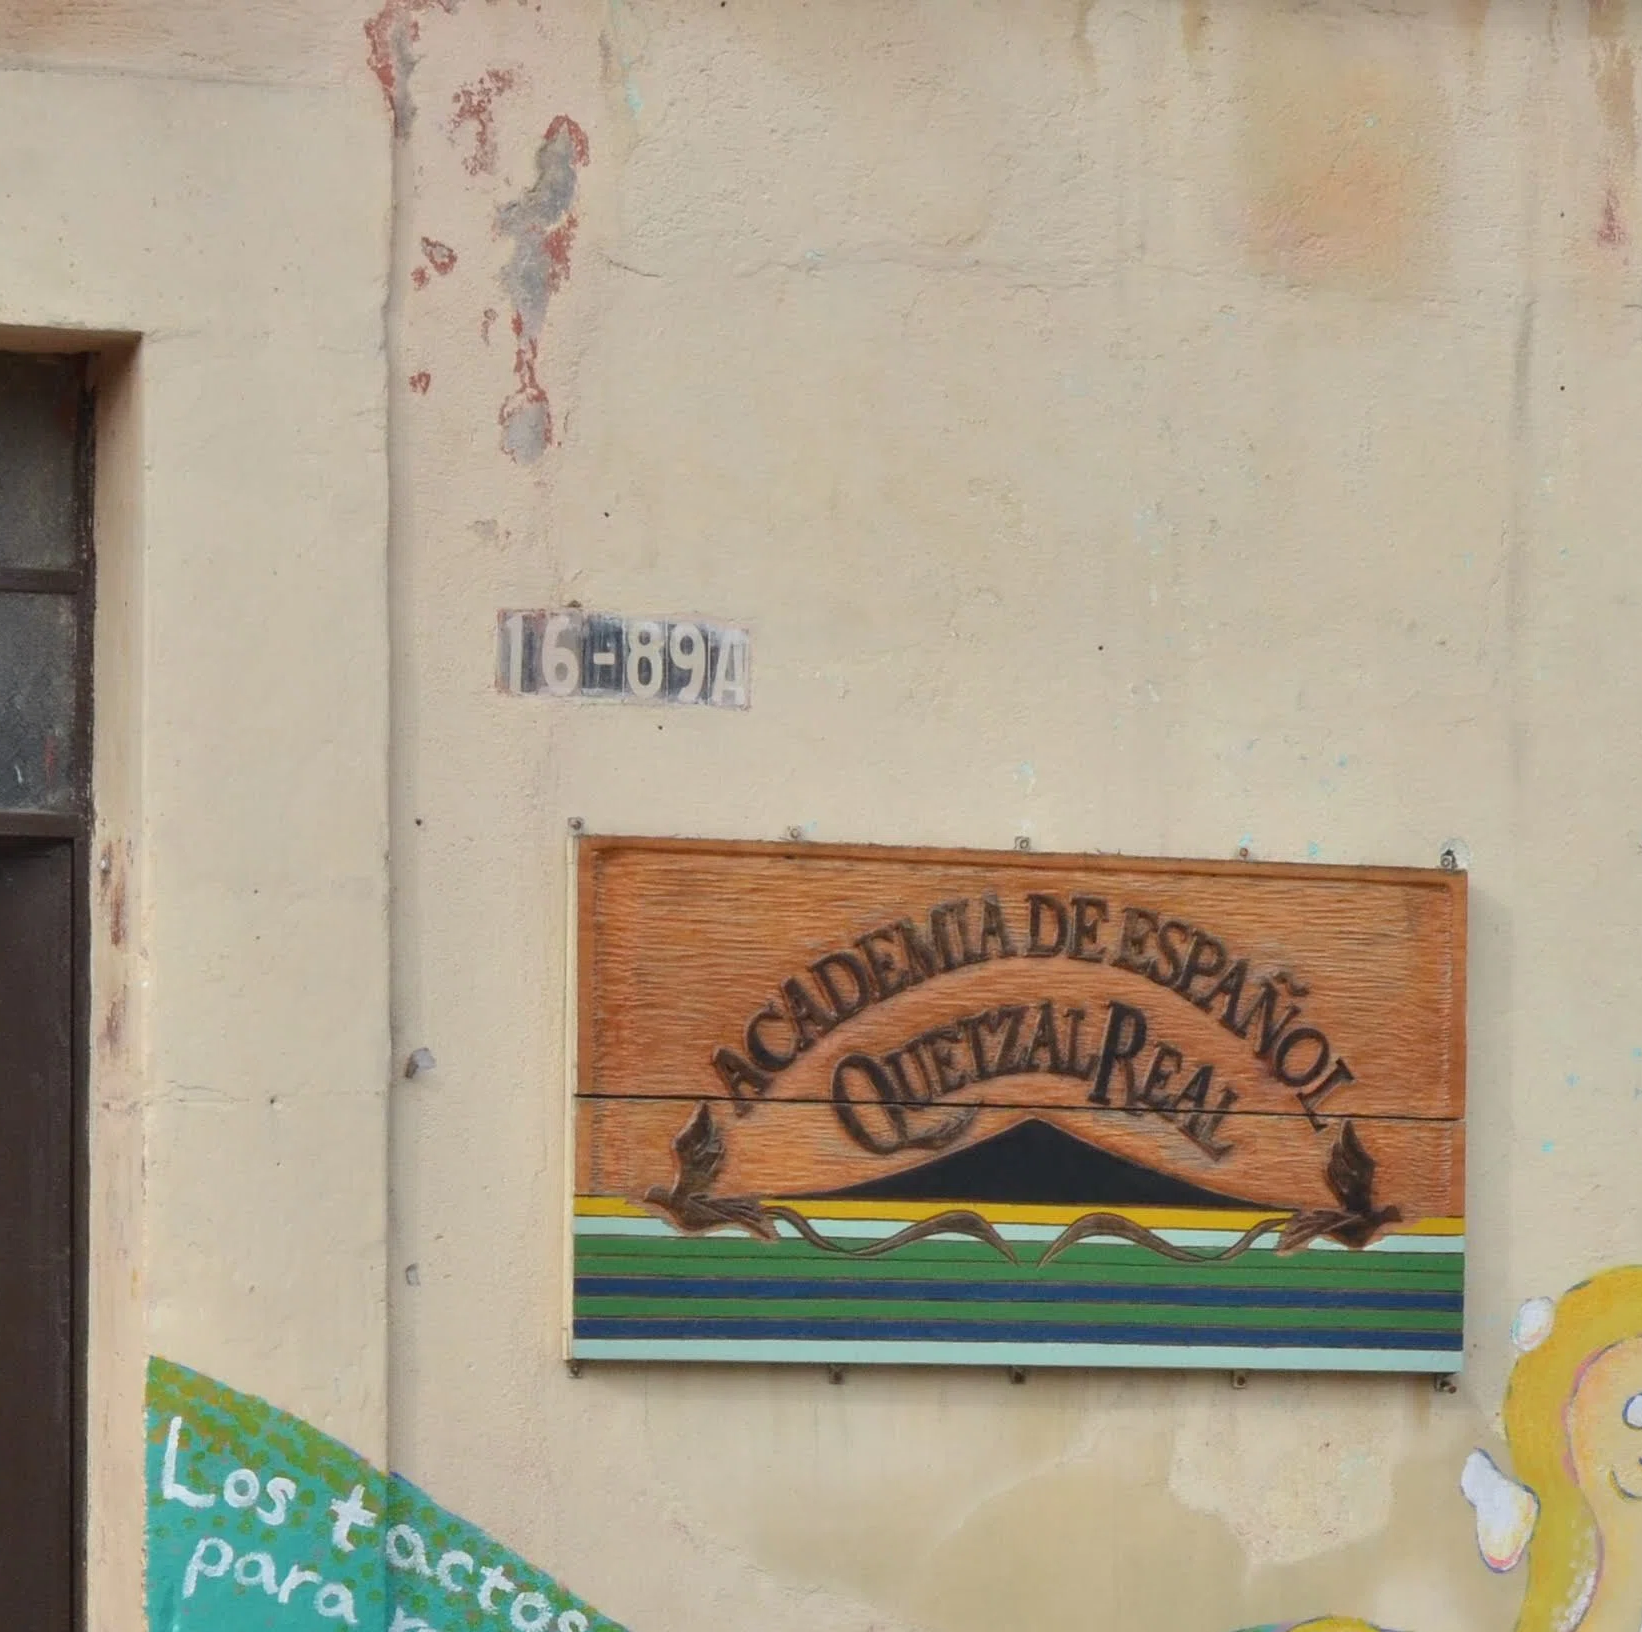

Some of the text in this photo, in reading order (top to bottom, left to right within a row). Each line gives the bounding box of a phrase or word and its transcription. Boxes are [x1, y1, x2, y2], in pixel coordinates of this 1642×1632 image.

[507, 612, 748, 705] 16-89A
[711, 890, 1359, 1133] ACADEMIA DE ESPAÑOL
[831, 1000, 1242, 1161] QUETZAL REAL
[162, 1416, 297, 1525] Los
[184, 1538, 358, 1625] para
